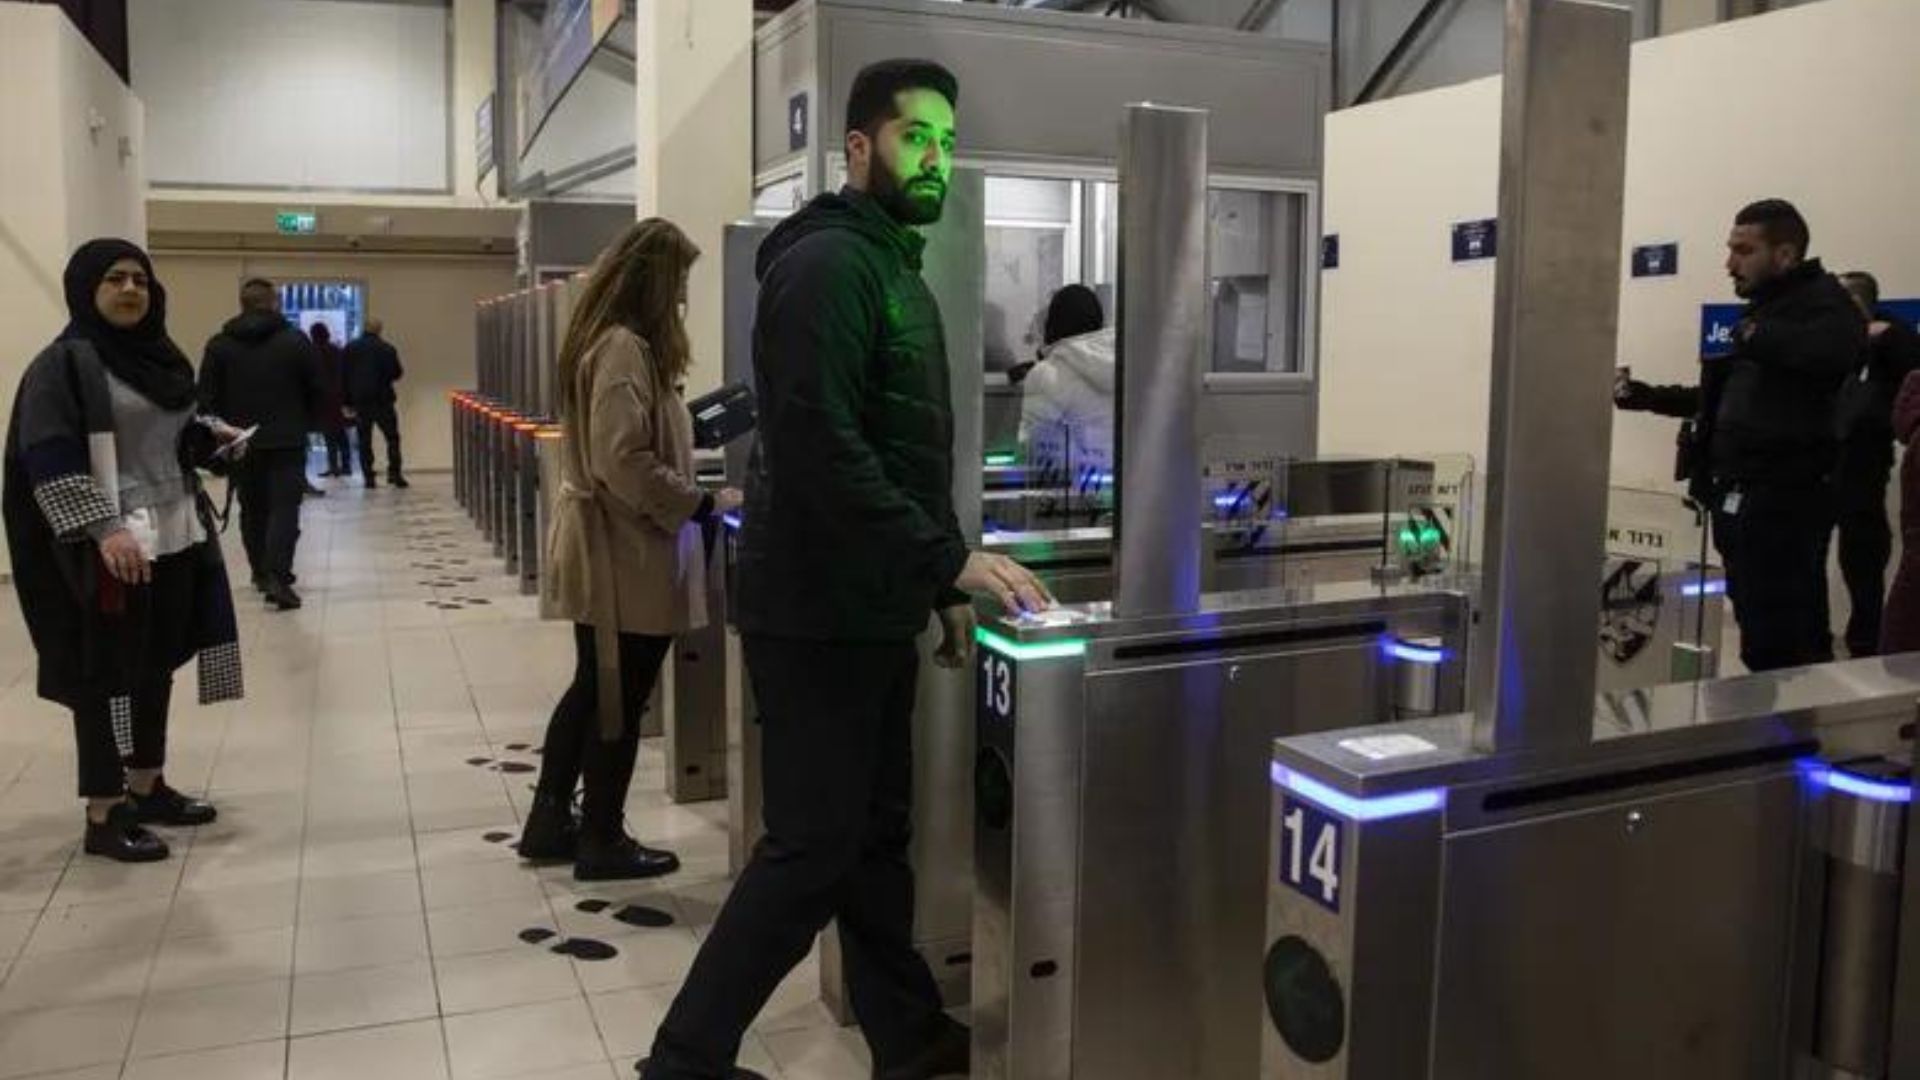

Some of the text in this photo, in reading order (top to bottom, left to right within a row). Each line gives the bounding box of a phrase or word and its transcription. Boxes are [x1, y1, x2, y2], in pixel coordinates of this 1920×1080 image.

[792, 107, 803, 135] 4
[1706, 321, 1733, 343] Je
[983, 654, 1010, 716] 13
[1284, 807, 1338, 902] 14
